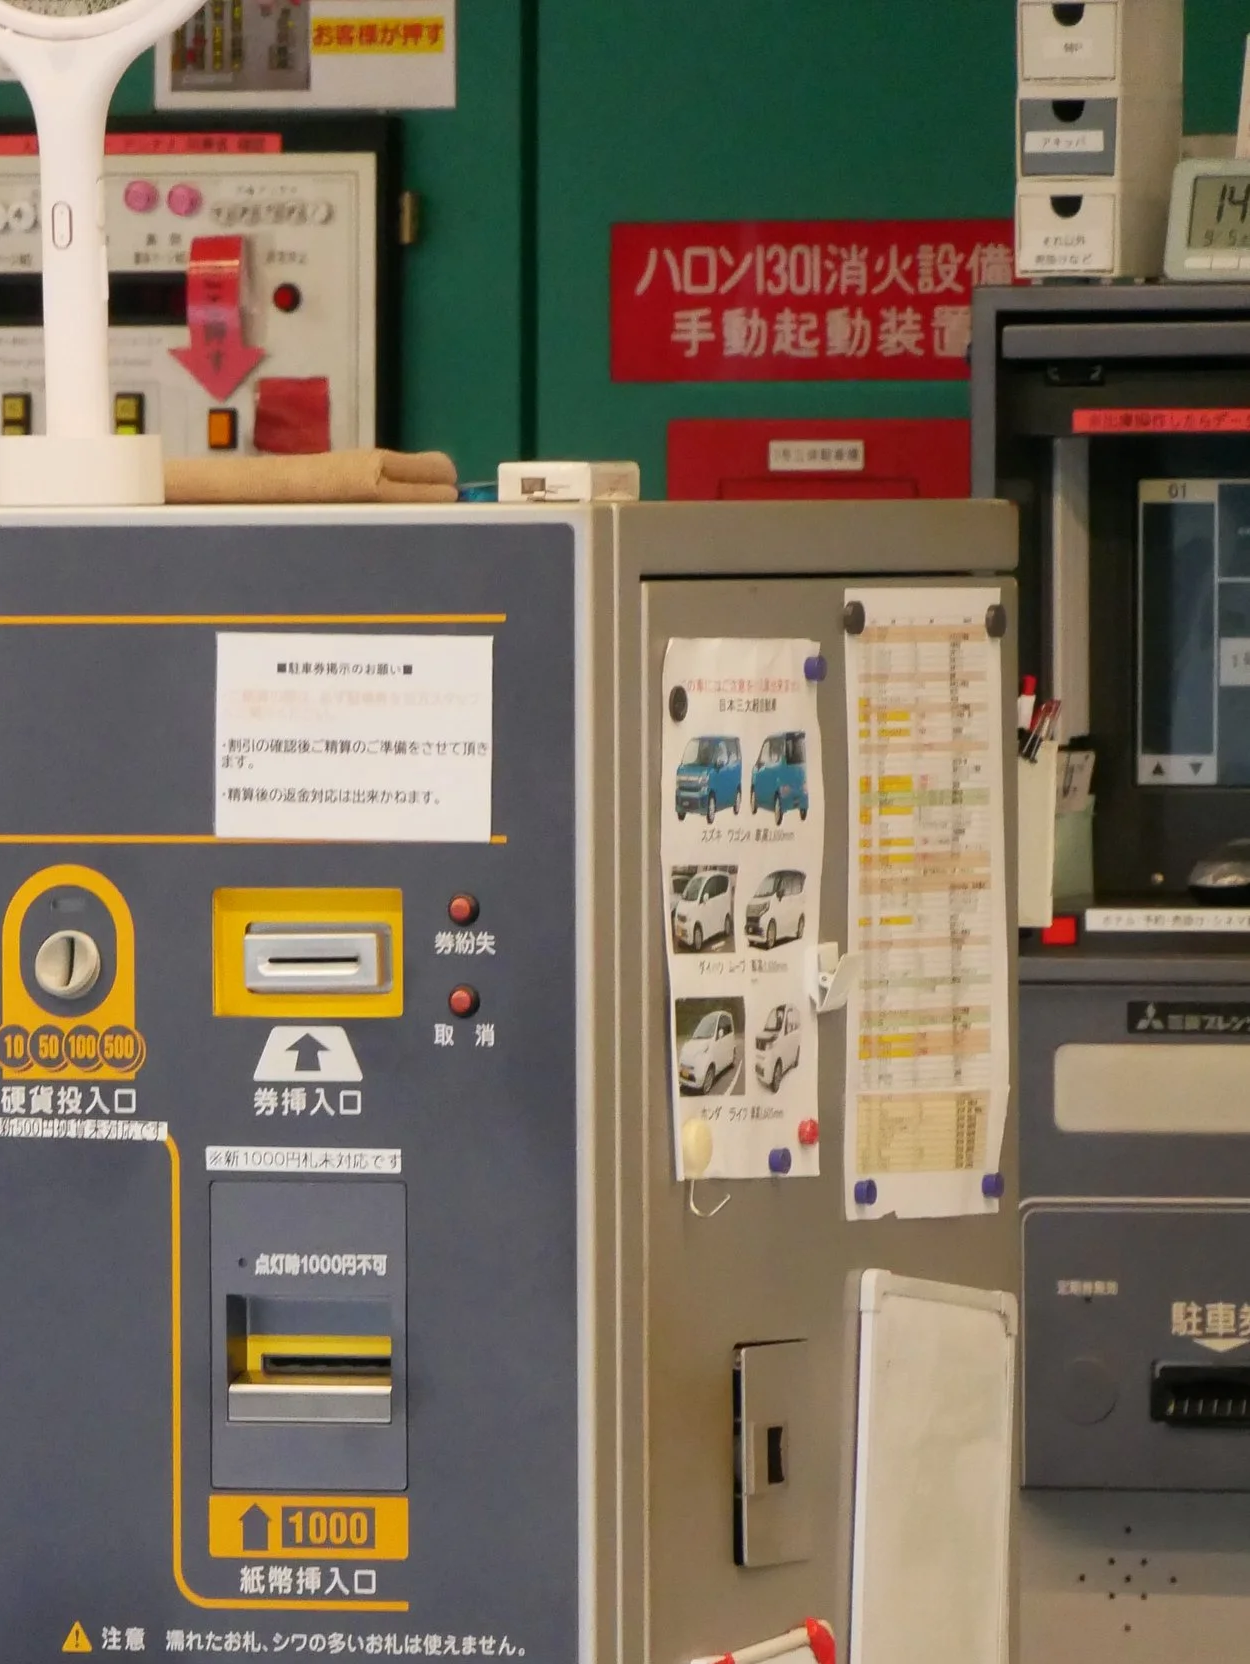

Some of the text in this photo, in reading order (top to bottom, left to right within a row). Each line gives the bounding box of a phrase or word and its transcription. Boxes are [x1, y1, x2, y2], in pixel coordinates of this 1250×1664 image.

[313, 23, 443, 46] お客様が押す
[671, 304, 971, 359] 手動起動装置
[1168, 483, 1187, 498] 01
[221, 754, 255, 769] ます。
[435, 931, 496, 955] 券紛失
[4, 1034, 24, 1058] 10
[38, 1034, 60, 1058] 50
[68, 1034, 97, 1058] 100
[103, 1034, 135, 1058] 500
[1, 1086, 137, 1115] 硬貨投入口
[253, 1087, 362, 1116] 券挿入口
[208, 1149, 402, 1173] ※新1000円札未対応です
[255, 1253, 388, 1277] 点灯時1000円不可
[288, 1511, 369, 1545] 1000
[240, 1567, 377, 1596] 紙幣挿入口
[101, 1626, 527, 1657] 注意 濡れたお札、シワの多いお札は使えません。
